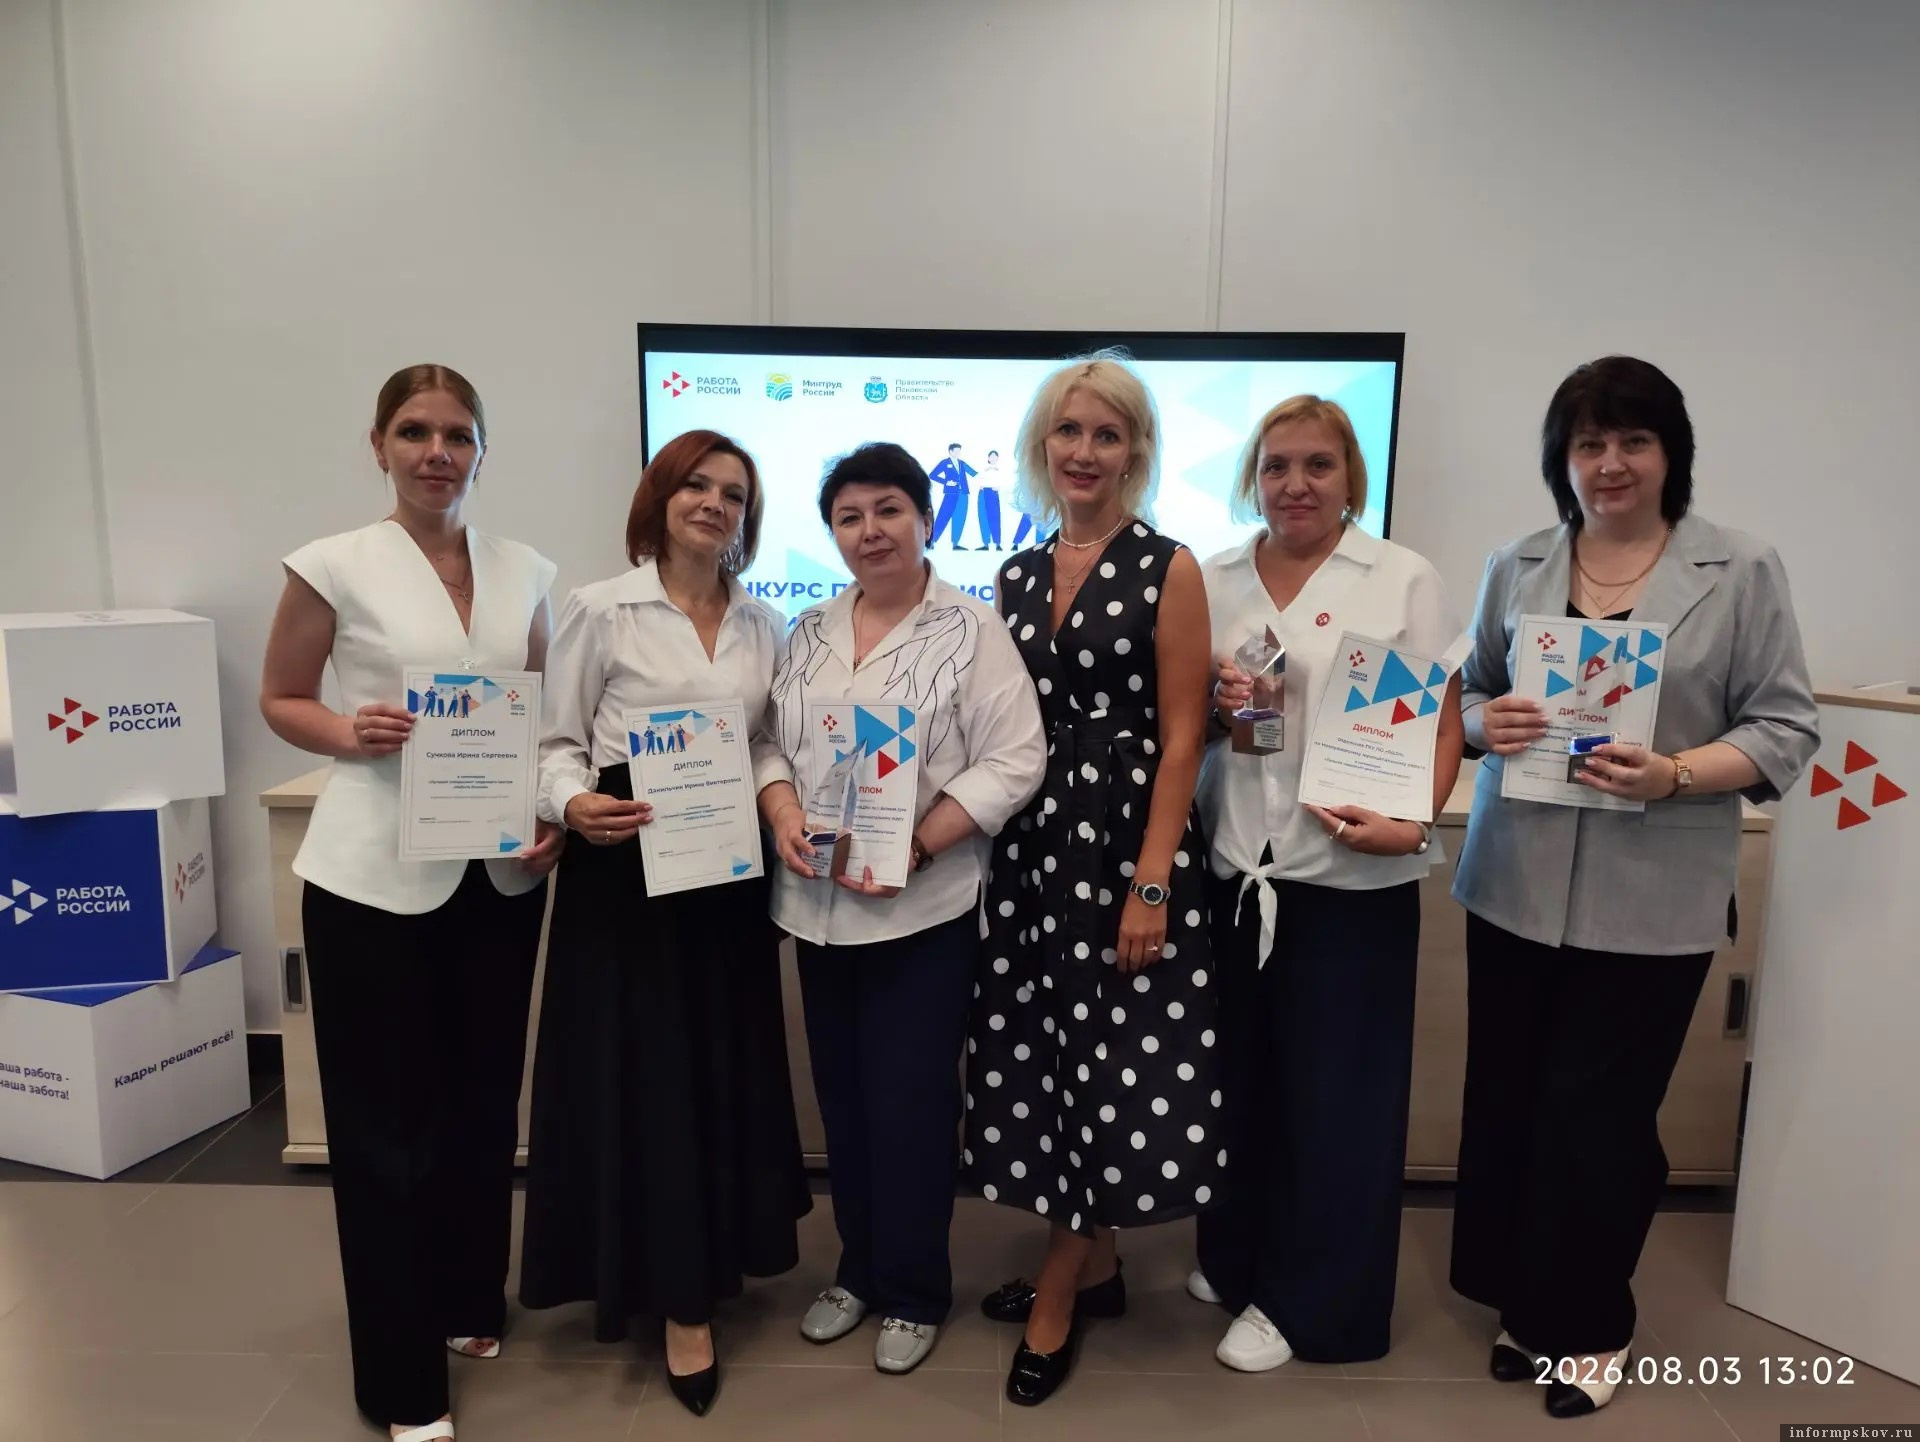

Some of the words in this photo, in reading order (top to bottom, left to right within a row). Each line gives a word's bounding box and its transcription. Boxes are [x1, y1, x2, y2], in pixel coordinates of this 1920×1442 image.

[697, 377, 738, 386] РАБОТА
[802, 380, 842, 389] Минтруд
[697, 386, 741, 395] РОССИИ
[802, 389, 835, 397] России
[108, 701, 178, 718] РАБОТА
[109, 716, 181, 732] РОССИИ
[451, 728, 495, 738] ДИПЛОМ
[1352, 723, 1394, 740] ДИПЛОМ
[673, 759, 713, 772] ДИПЛОМ
[684, 782, 705, 790] Ирина
[858, 786, 883, 794] ПЛОМ
[56, 885, 126, 900] РАБОТА
[57, 900, 131, 915] РОССИИ
[114, 1063, 158, 1088] Кадры
[160, 1042, 209, 1070] решают
[211, 1029, 235, 1048] всё!
[0, 1062, 21, 1074] аша
[24, 1067, 63, 1082] работа
[29, 1085, 70, 1100] забота!
